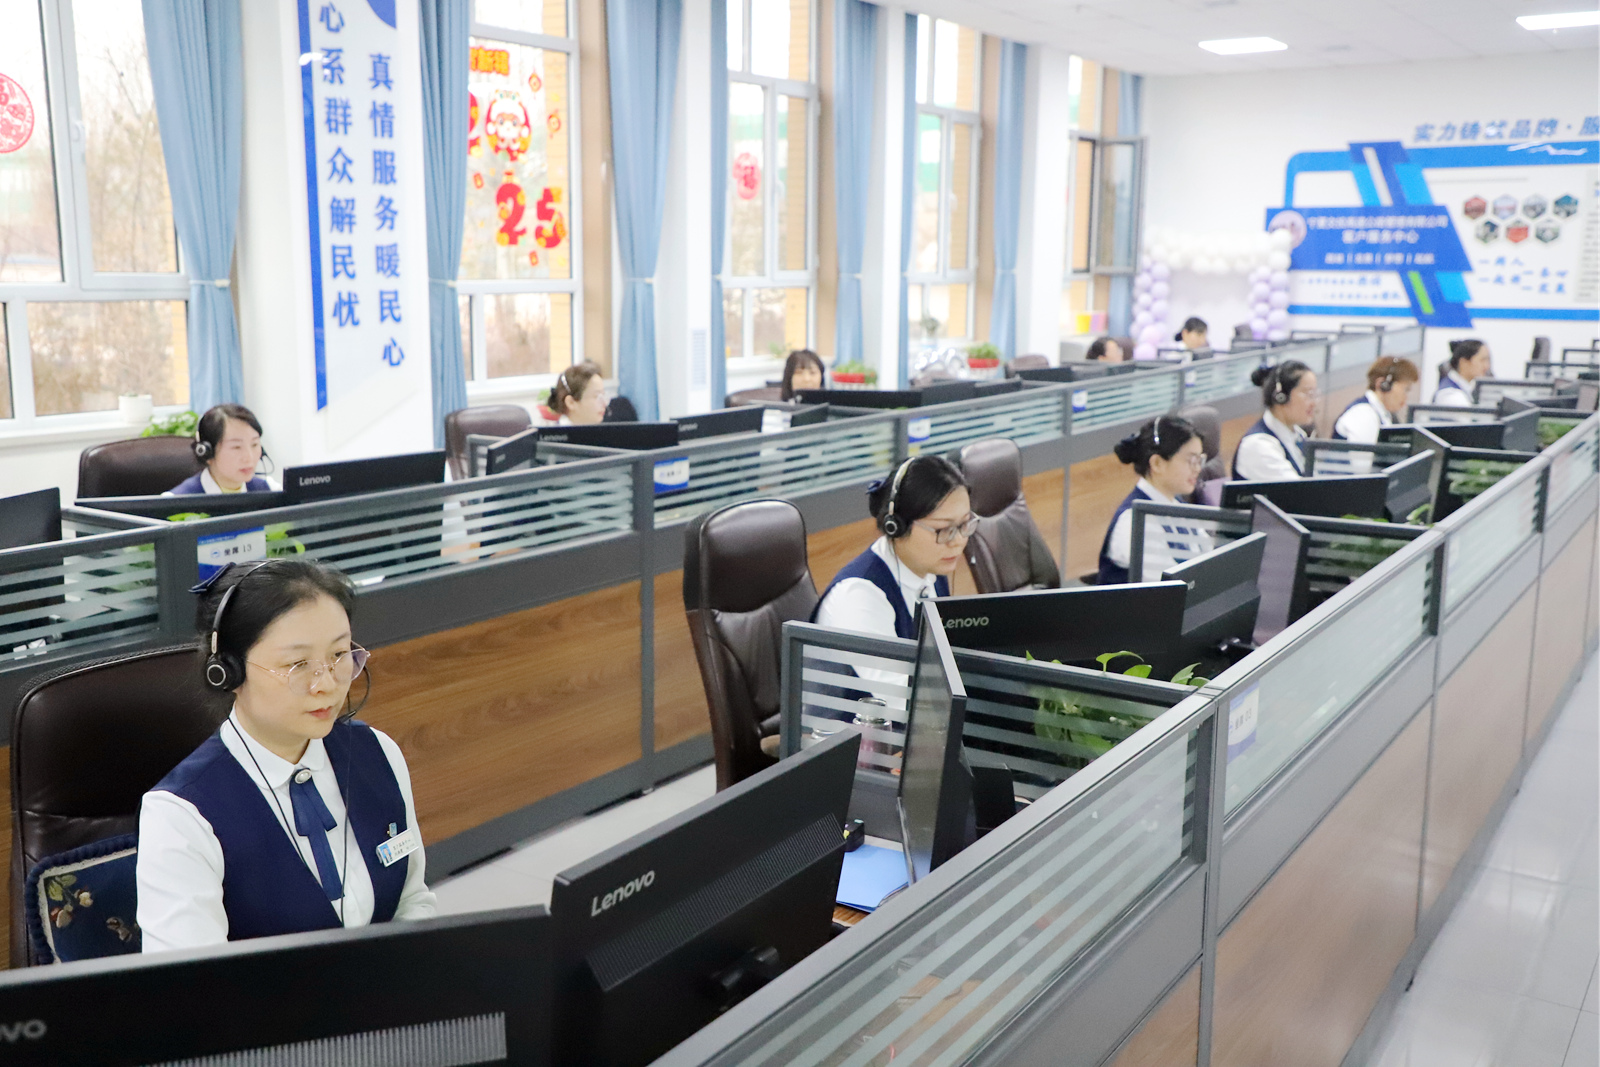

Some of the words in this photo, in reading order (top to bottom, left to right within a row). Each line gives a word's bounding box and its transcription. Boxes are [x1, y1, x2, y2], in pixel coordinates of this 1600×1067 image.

[320, 1, 360, 328] 心系群众解民忧
[369, 53, 405, 367] 真情服务暖民心
[299, 474, 332, 487] Lenovo
[590, 869, 656, 918] Lenovo
